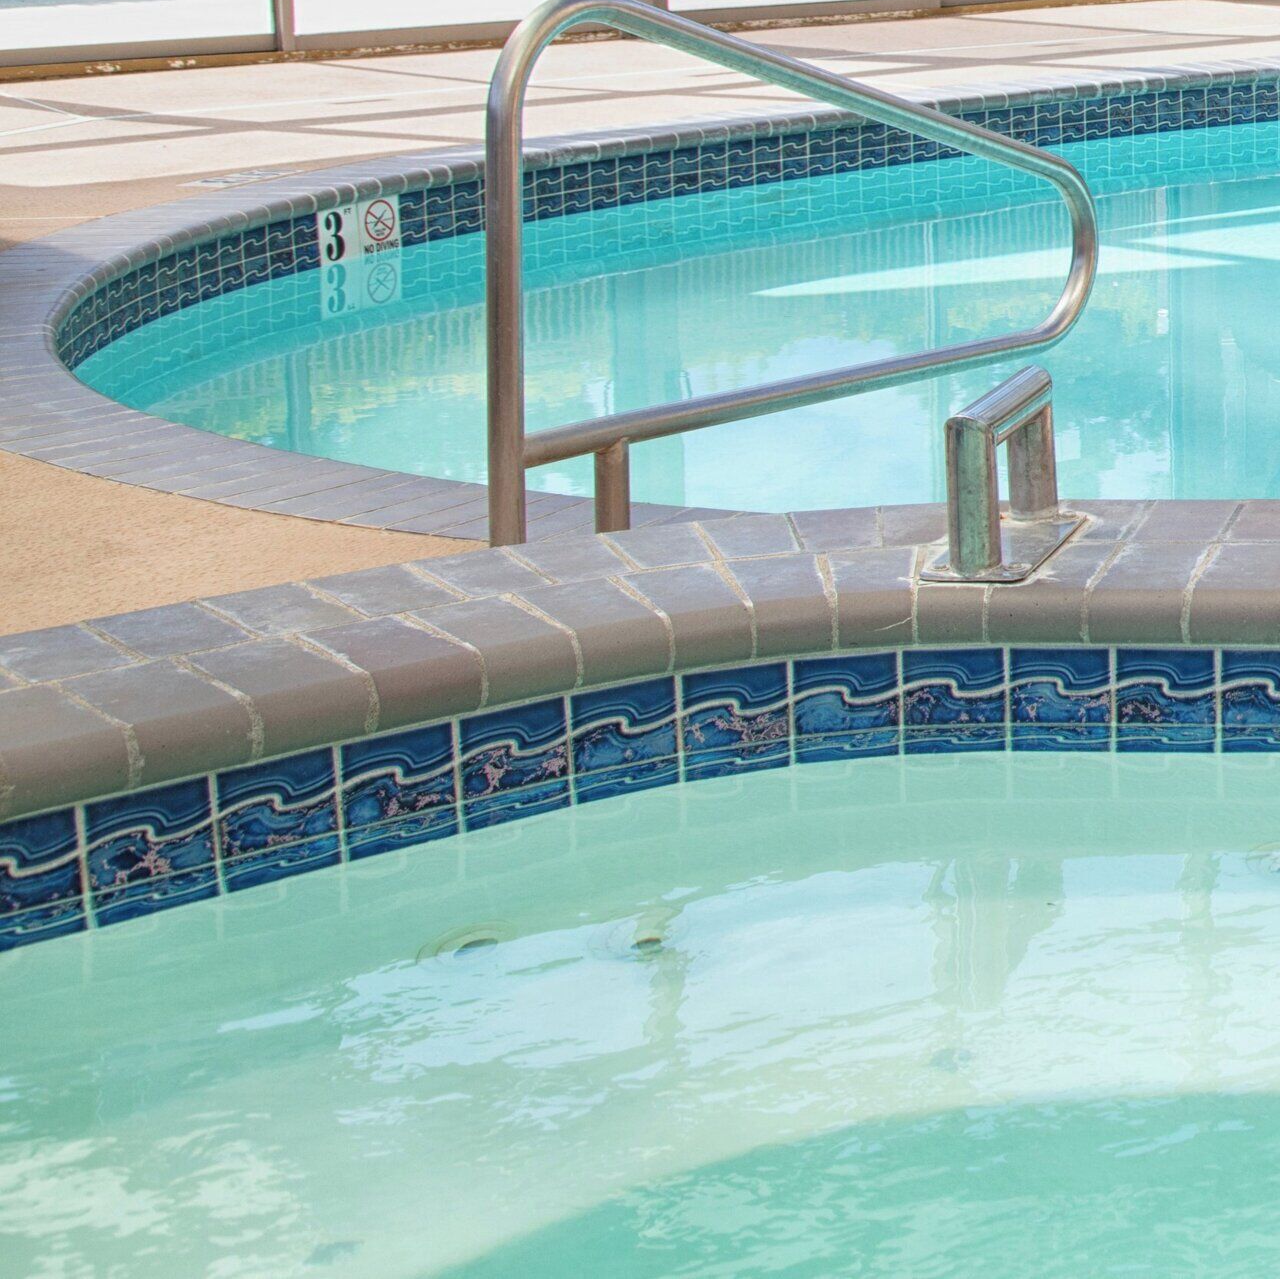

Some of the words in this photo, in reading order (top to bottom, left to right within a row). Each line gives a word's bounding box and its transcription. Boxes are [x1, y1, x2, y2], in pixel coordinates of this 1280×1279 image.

[325, 211, 346, 262] 3
[364, 243, 374, 254] NO
[376, 238, 400, 252] DIVING
